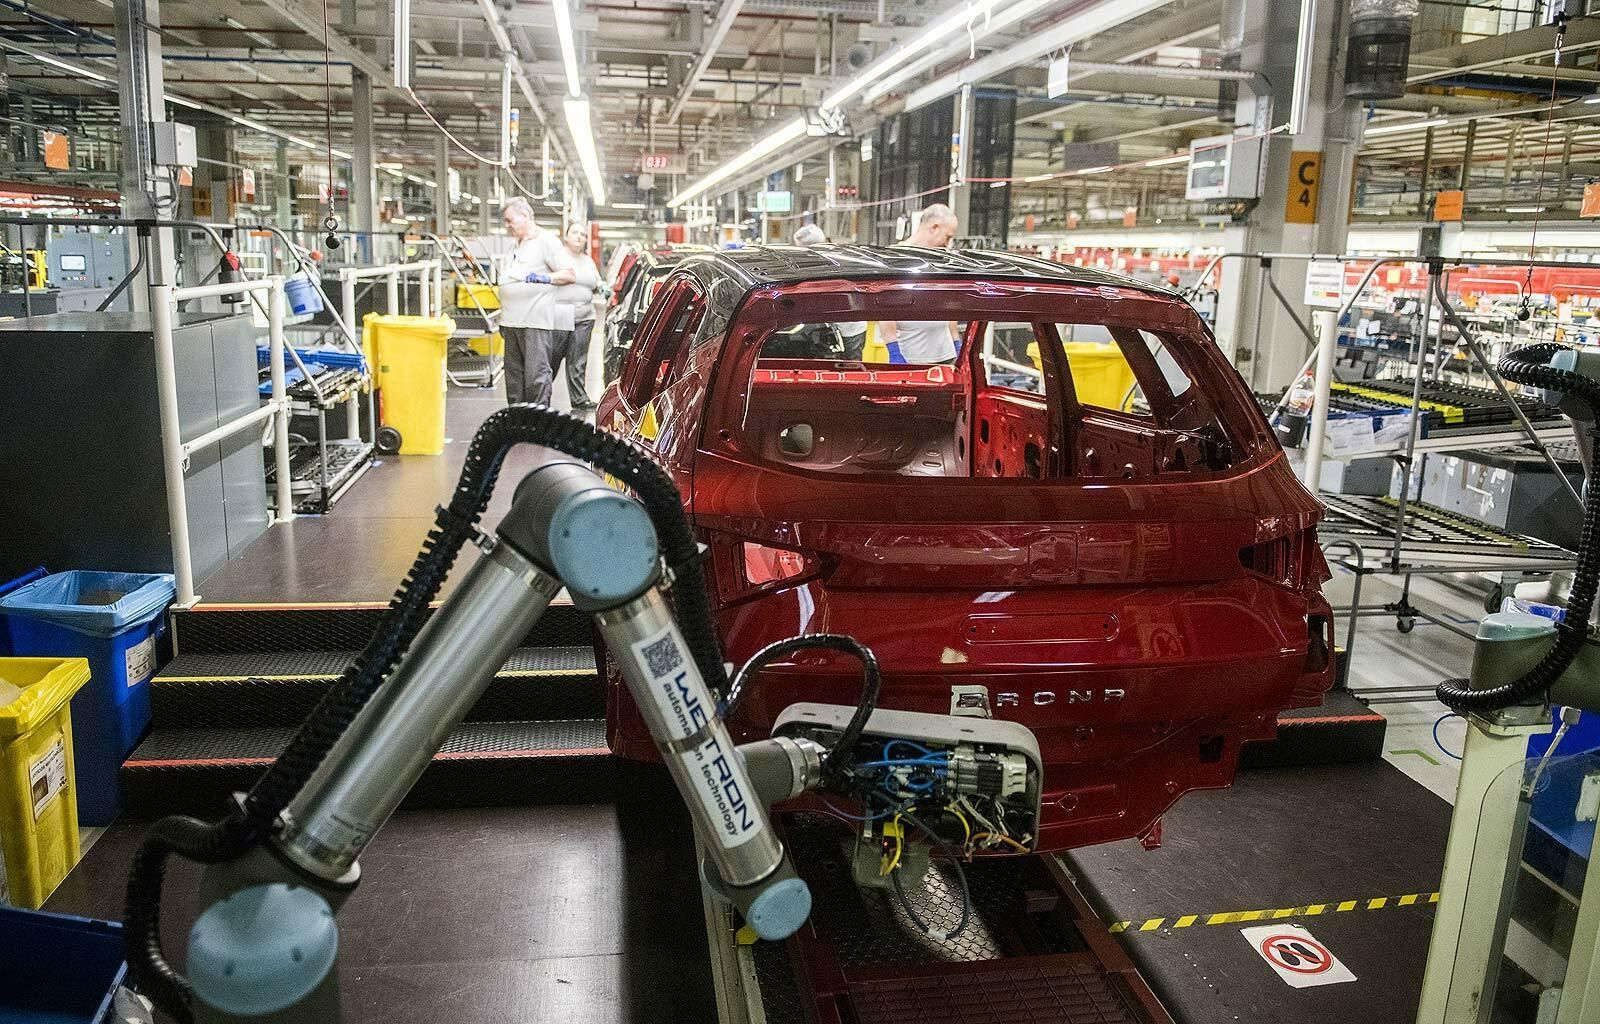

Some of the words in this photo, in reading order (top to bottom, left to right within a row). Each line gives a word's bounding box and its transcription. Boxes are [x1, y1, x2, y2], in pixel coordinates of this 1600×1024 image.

[1298, 160, 1316, 186] C
[1298, 188, 1311, 208] 4
[701, 763, 739, 836] technology
